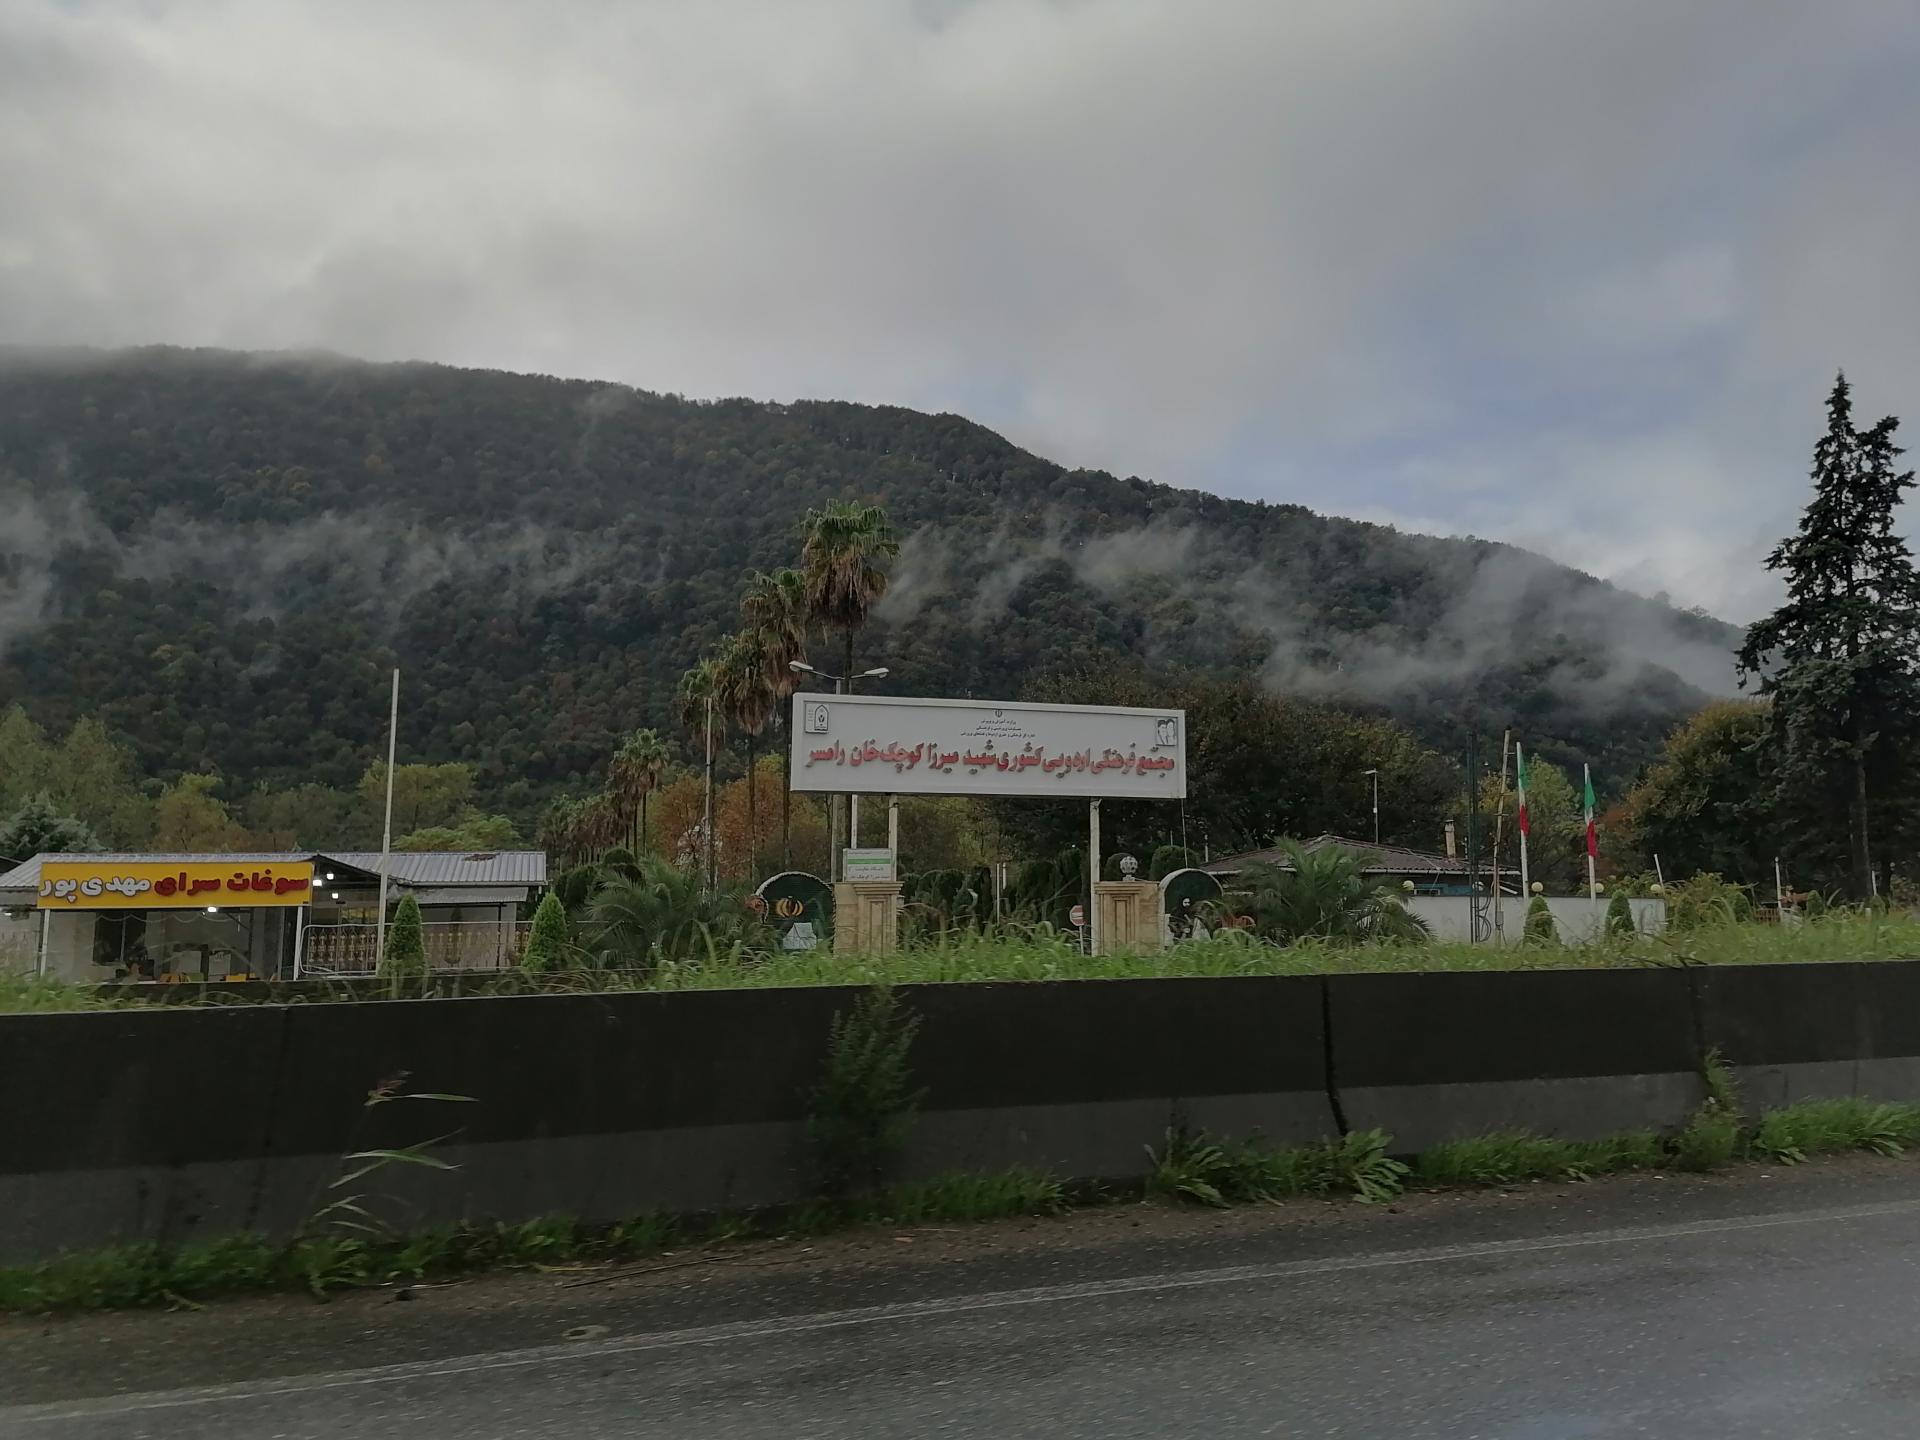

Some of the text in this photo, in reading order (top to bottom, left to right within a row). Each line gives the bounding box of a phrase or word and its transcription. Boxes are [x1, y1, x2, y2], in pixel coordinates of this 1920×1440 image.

[805, 739, 846, 768] رامسر
[849, 738, 880, 767] خان
[879, 740, 924, 773] کوچک
[927, 742, 959, 774] میرزا
[962, 739, 997, 775] شهید
[996, 741, 1044, 773] کشوری
[1090, 742, 1137, 775] فرهنگی
[1136, 746, 1175, 778] مجتمع
[39, 869, 309, 904] سوغات سرای مهدی پور
